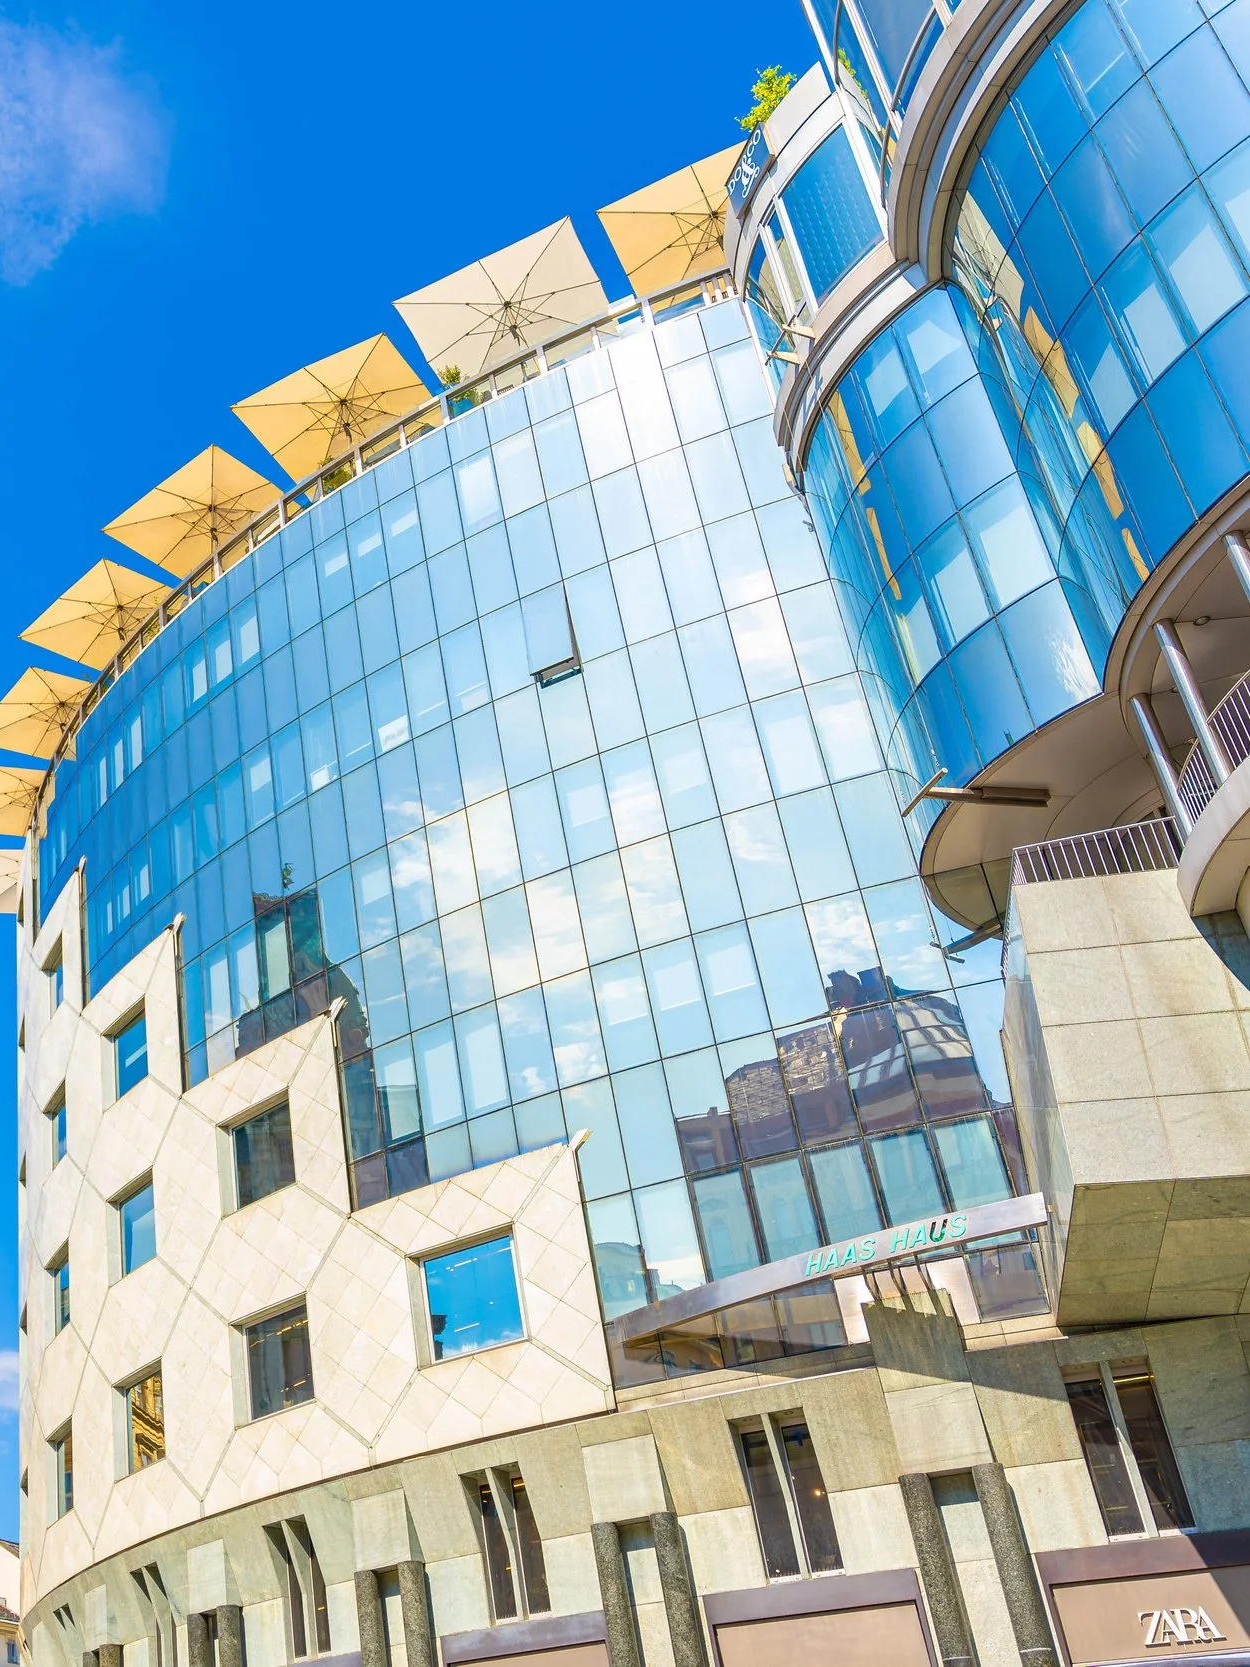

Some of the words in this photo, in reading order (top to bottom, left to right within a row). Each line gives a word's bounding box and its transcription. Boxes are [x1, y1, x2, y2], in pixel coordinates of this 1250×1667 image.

[805, 1238, 876, 1277] HAAS
[890, 1215, 968, 1253] HAUS
[1137, 1606, 1228, 1648] ZARA
